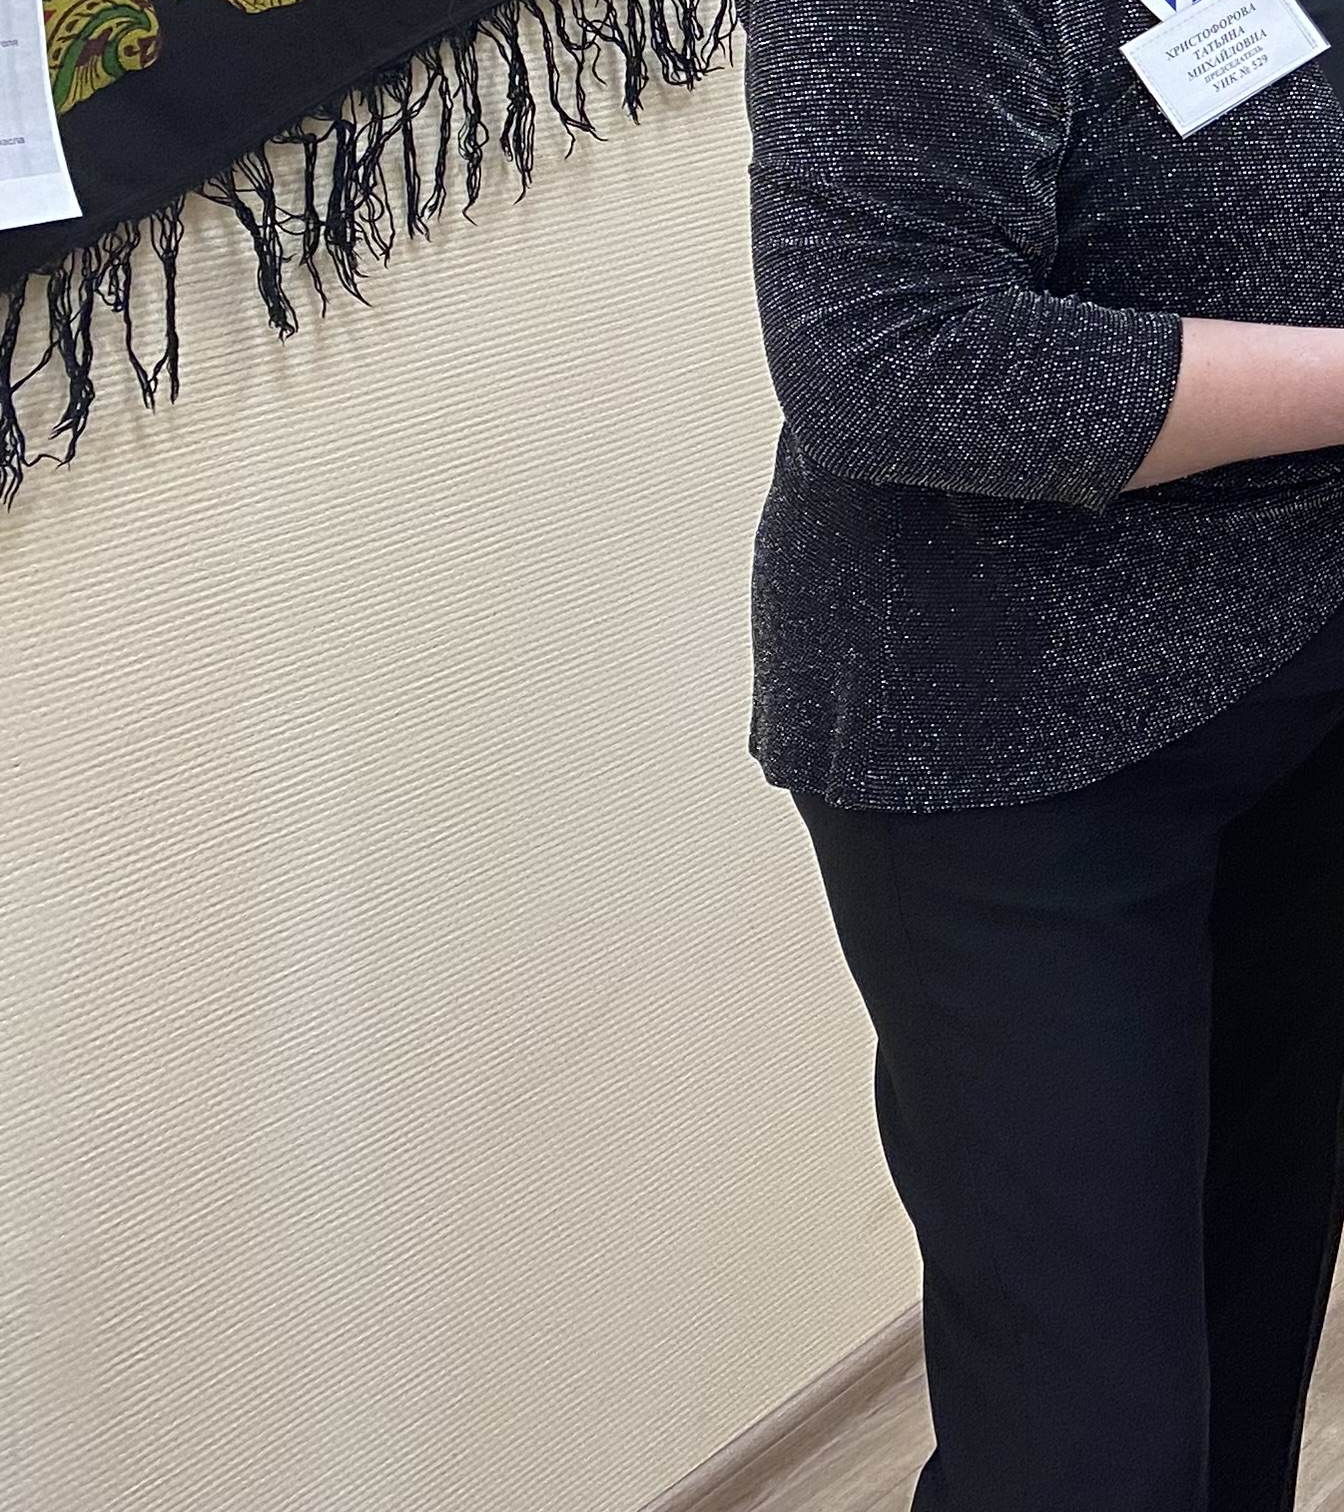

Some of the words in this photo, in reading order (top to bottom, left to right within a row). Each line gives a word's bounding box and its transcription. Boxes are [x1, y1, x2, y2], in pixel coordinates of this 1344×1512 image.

[1165, 2, 1257, 61] ХРИСТОФОРОВА
[1192, 25, 1246, 61] ТАТЬЯНА
[1186, 28, 1268, 82] МИХАЙЛОВНА
[1212, 72, 1239, 93] УИК
[1251, 54, 1269, 71] 529
